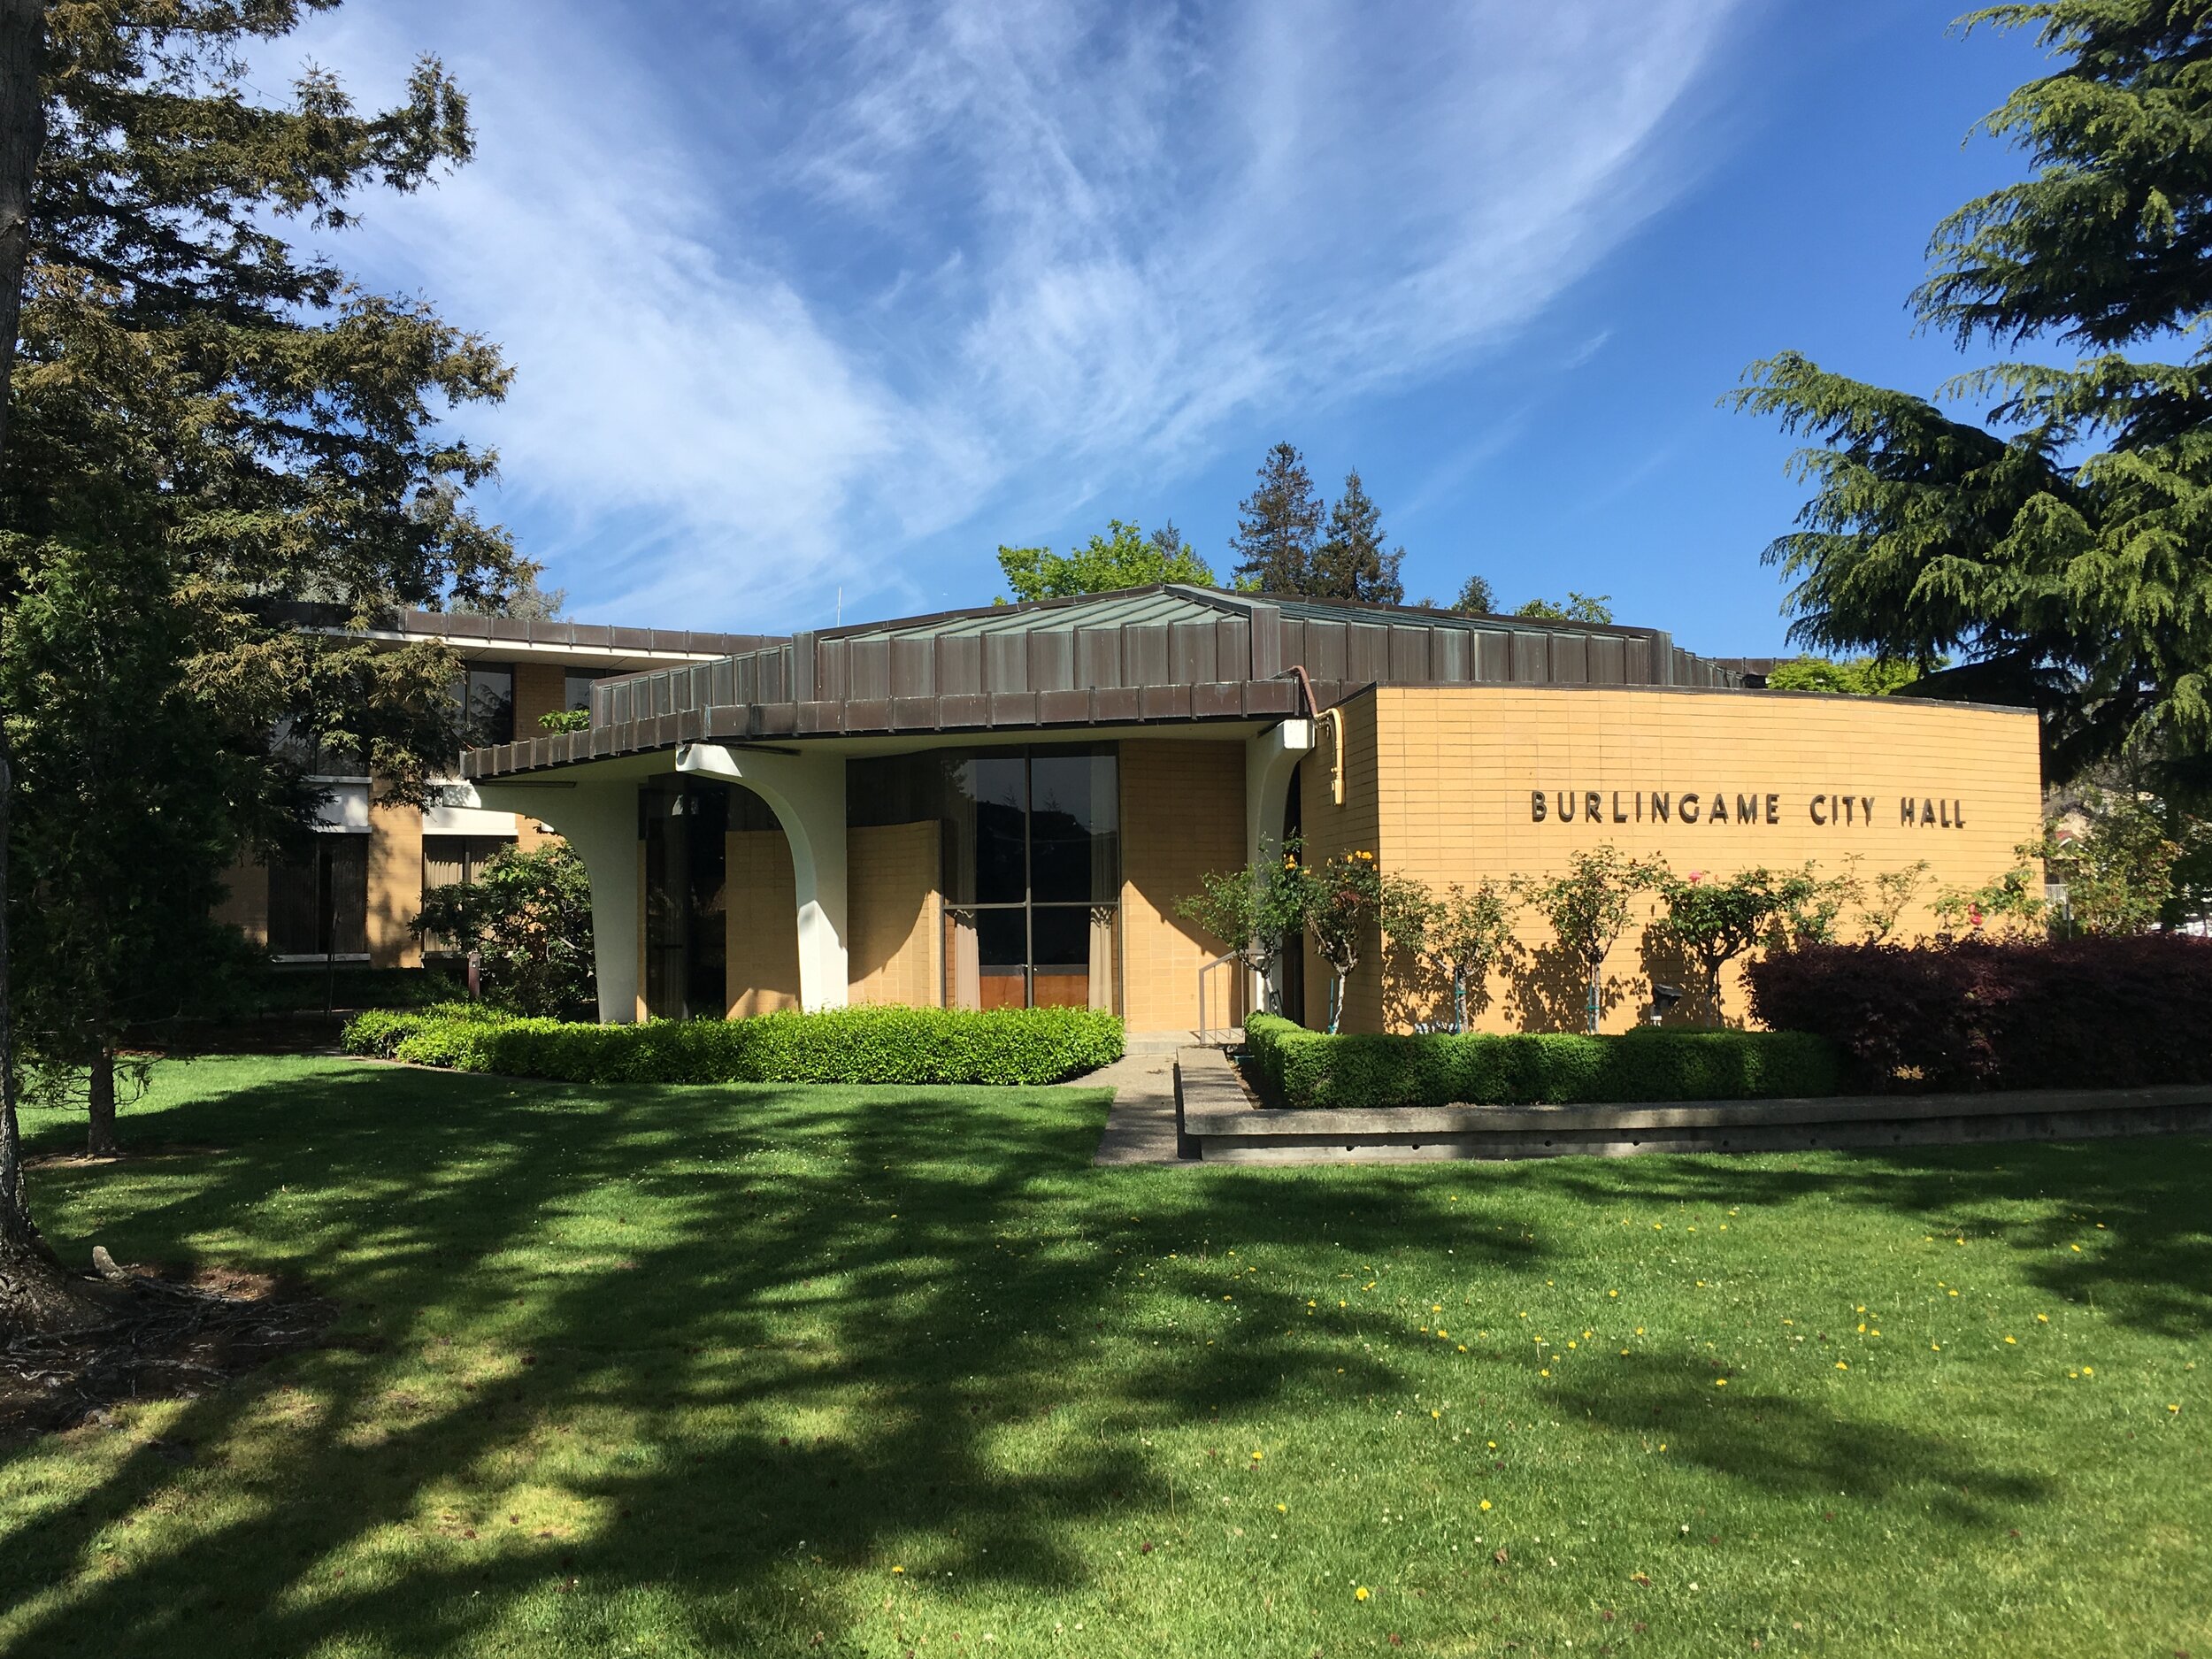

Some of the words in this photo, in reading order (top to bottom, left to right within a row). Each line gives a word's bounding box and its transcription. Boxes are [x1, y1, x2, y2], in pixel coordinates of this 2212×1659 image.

[1532, 790, 1779, 824] BURLINGAME
[1810, 794, 1875, 826] CITY
[1901, 797, 1966, 828] HALL
